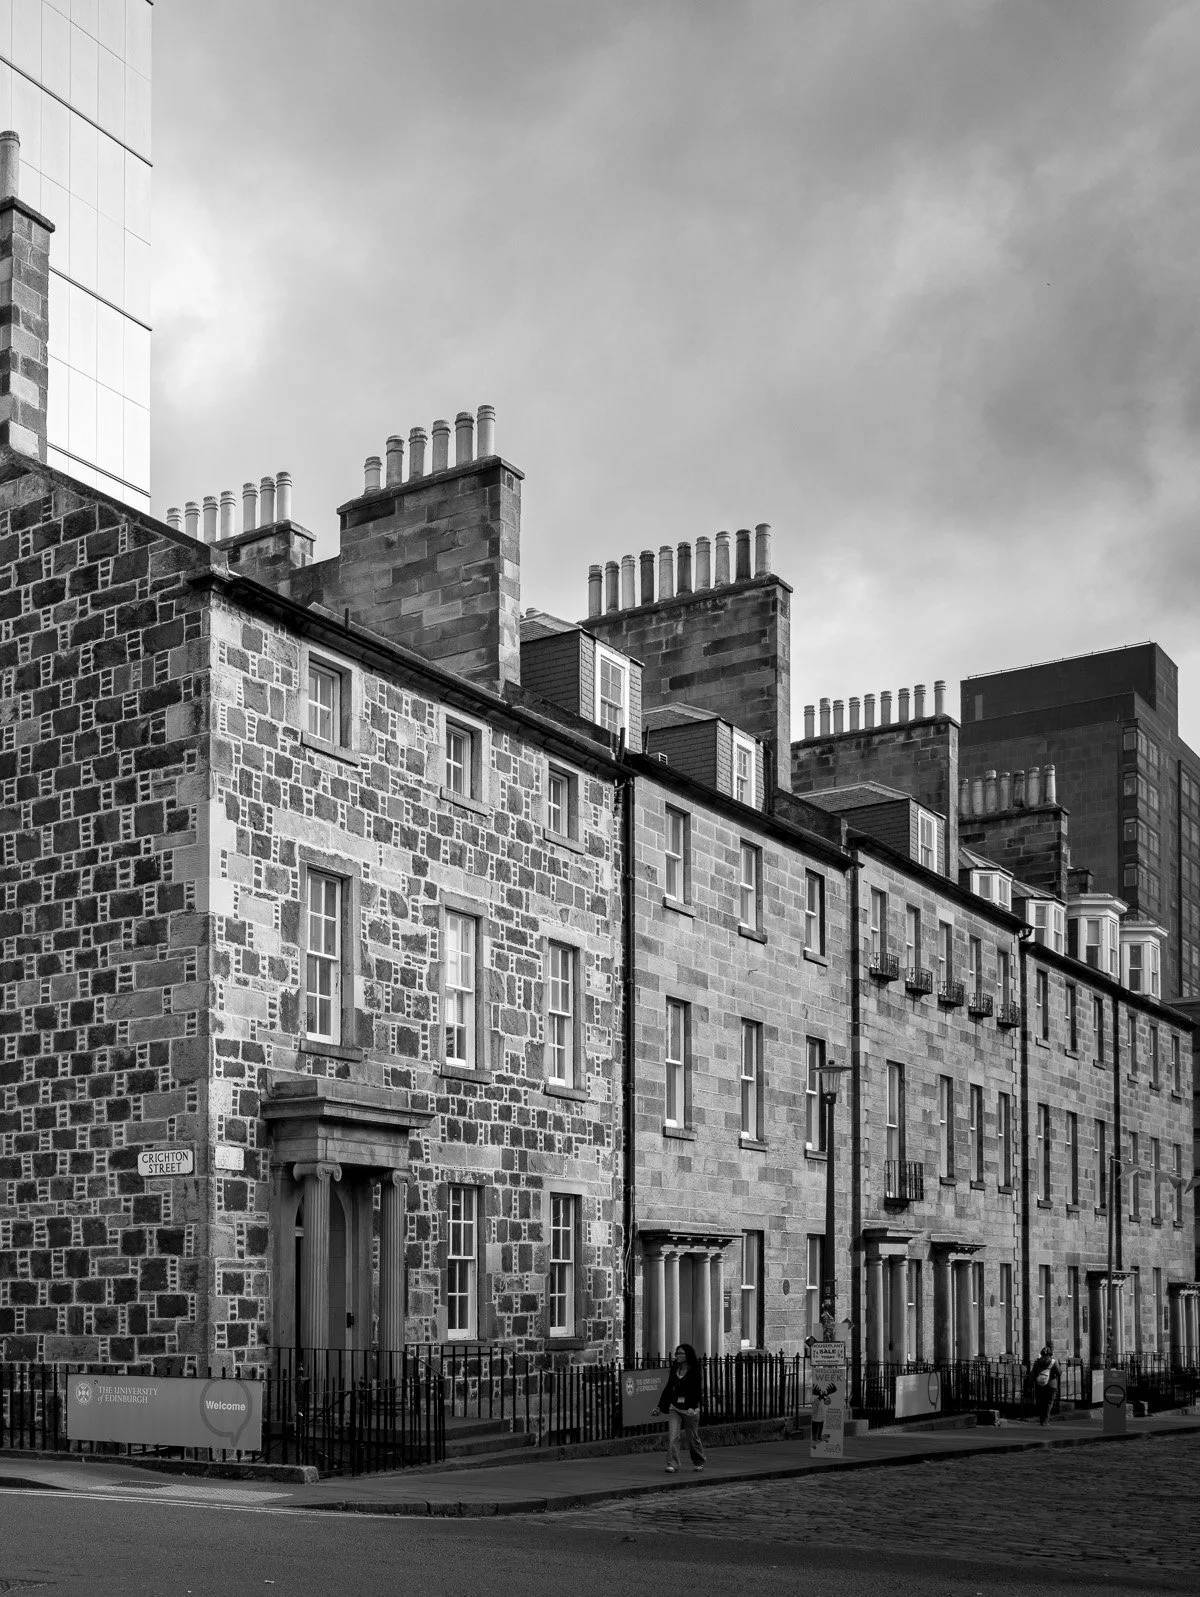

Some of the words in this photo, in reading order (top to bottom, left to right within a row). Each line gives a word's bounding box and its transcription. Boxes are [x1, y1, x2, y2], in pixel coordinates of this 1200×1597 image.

[142, 1152, 188, 1164] CRICHTON
[148, 1162, 182, 1174] STREET
[99, 1386, 113, 1394] THE
[114, 1386, 158, 1396] UNIVERSITY
[98, 1394, 104, 1404] of
[104, 1394, 148, 1404] EDINBURGH
[206, 1400, 246, 1411] Welcome
